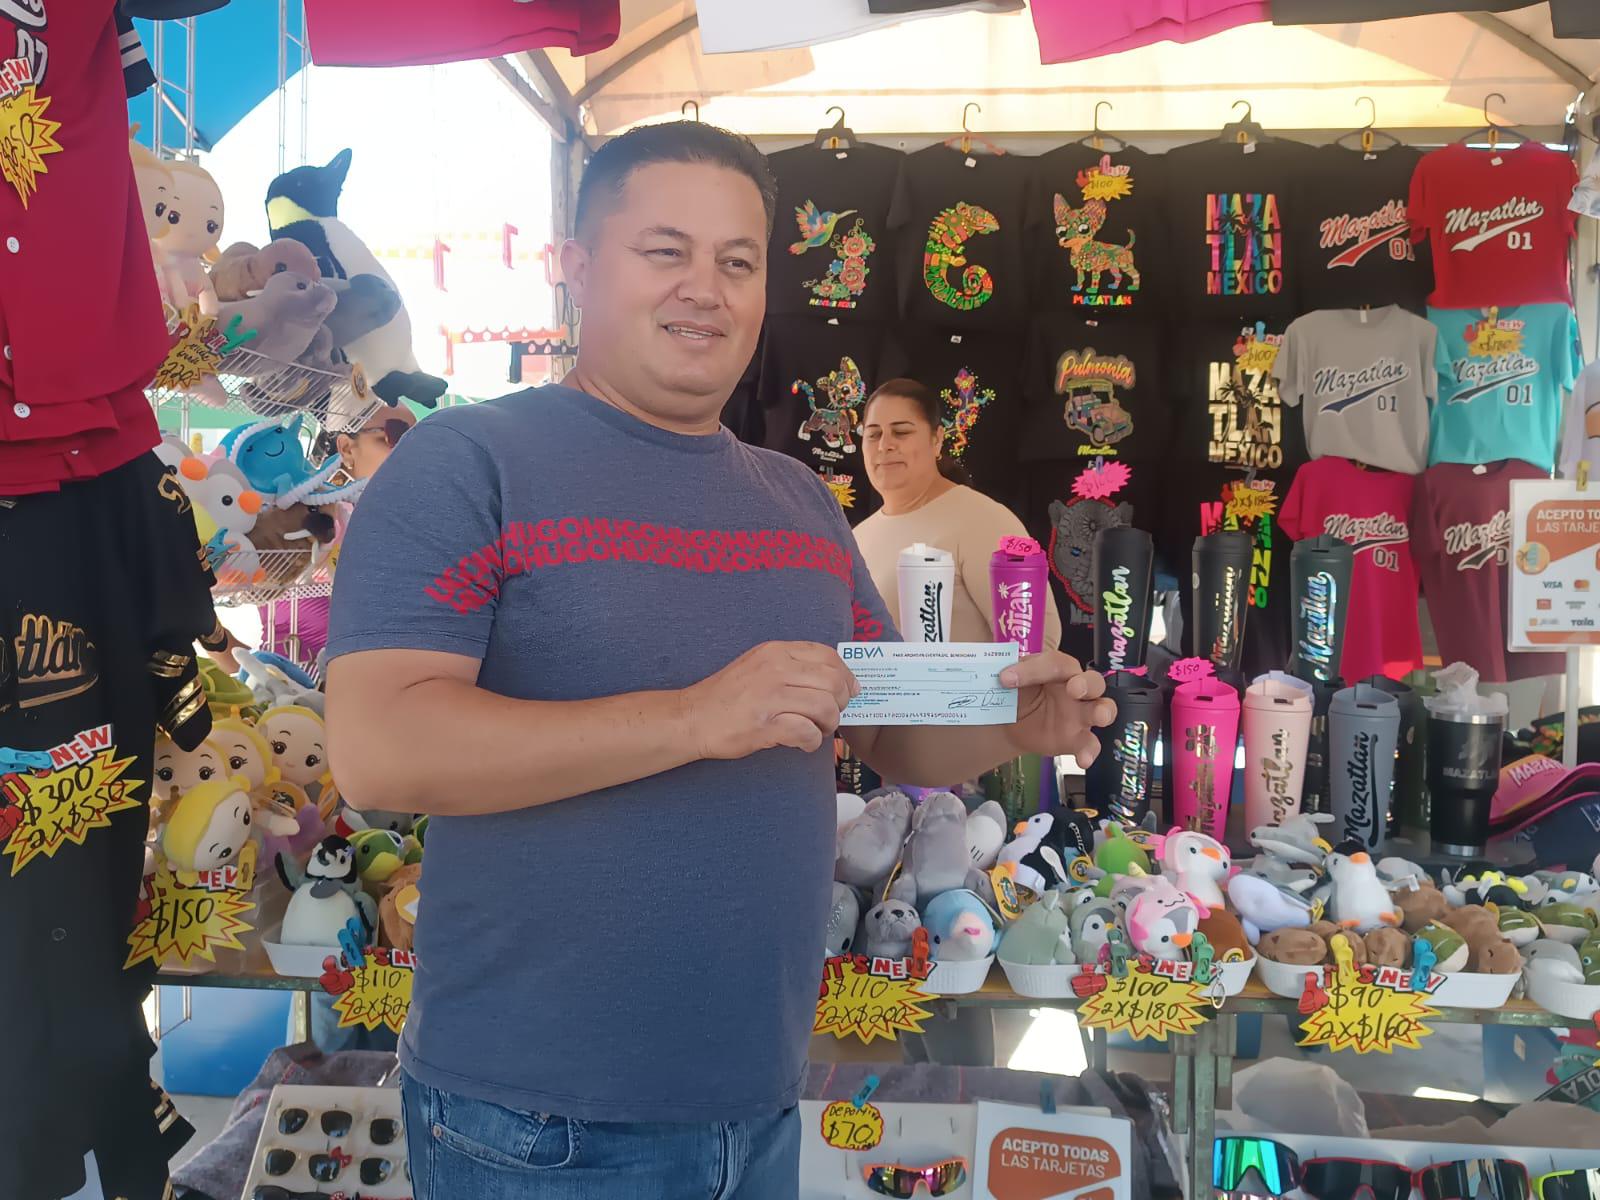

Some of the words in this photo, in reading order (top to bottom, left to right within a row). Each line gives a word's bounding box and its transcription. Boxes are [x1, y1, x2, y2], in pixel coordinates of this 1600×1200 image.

[1206, 192, 1281, 232] MAZA
[1206, 233, 1282, 271] TLAN
[1507, 231, 1533, 250] 01
[1206, 270, 1283, 295] MEXICO
[1073, 294, 1132, 306] MAZATLAN
[1377, 395, 1397, 412] 01
[1506, 385, 1533, 405] 01
[1208, 441, 1283, 469] MEXICO
[1536, 509, 1585, 520] ACEPTO
[1536, 522, 1560, 533] LAS
[1563, 522, 1599, 533] TARJE
[1373, 547, 1400, 572] 01
[1543, 581, 1563, 589] VISA
[919, 581, 938, 643] zatlan
[843, 646, 884, 660] BBVA
[1175, 664, 1200, 675] $150
[51, 725, 109, 766] NEW
[1257, 728, 1294, 828] azatlan
[22, 766, 94, 827] $300
[144, 898, 214, 948] $150
[356, 970, 402, 994] $110
[832, 976, 889, 1000] $110
[1111, 976, 1168, 998] $100
[1328, 976, 1384, 1016] $90
[829, 1121, 874, 1145] $70
[1001, 1137, 1060, 1157] ACEPTO
[1062, 1144, 1110, 1164] TODAS
[1001, 1153, 1030, 1169] LAS
[1032, 1156, 1106, 1179] TARJETAS
